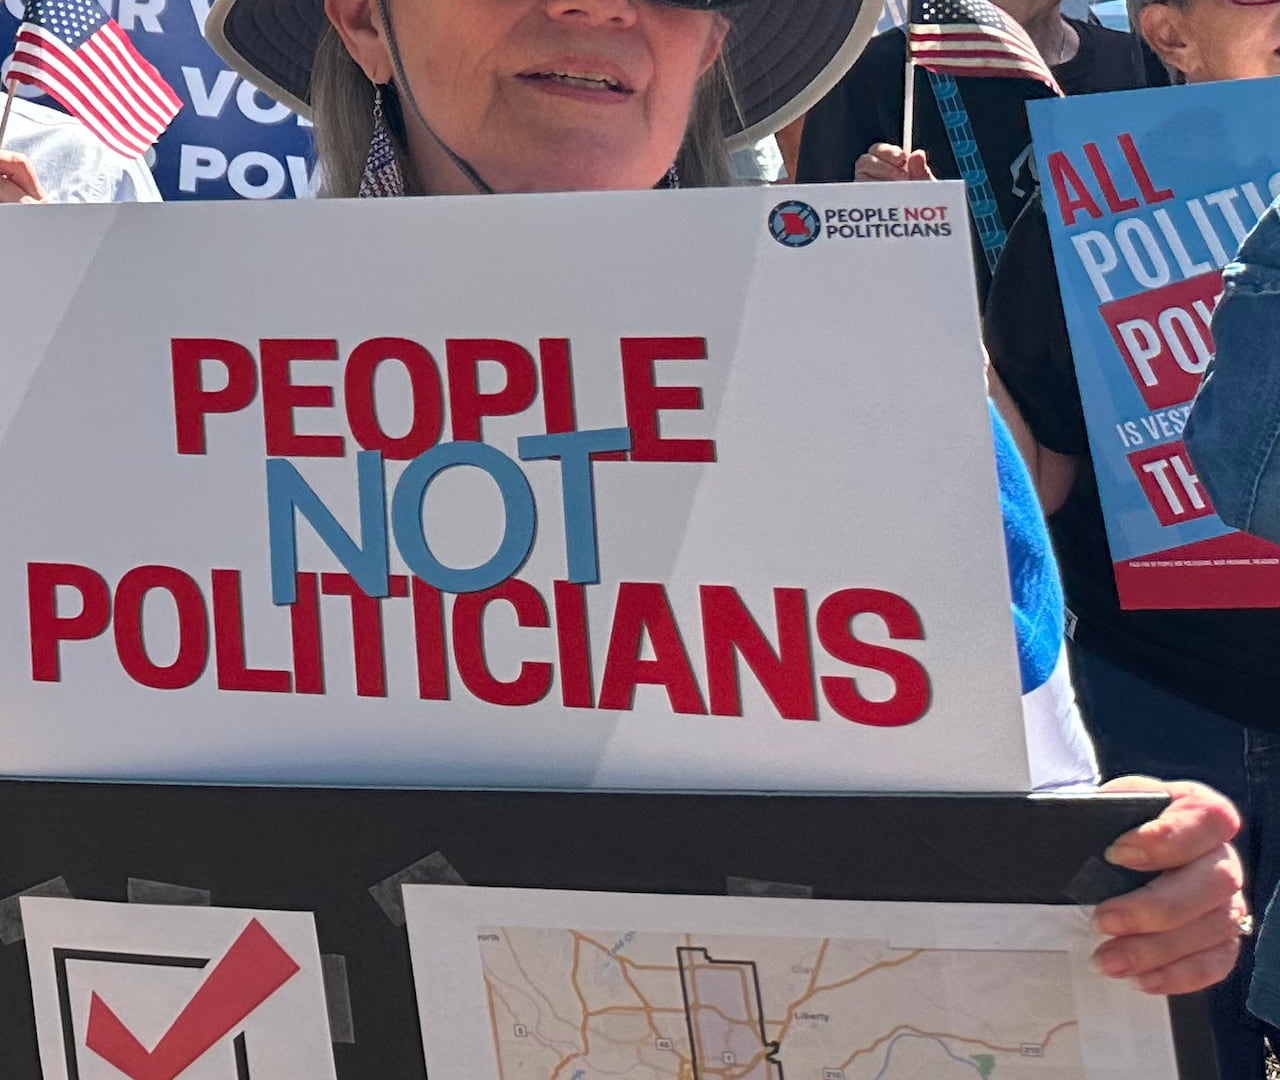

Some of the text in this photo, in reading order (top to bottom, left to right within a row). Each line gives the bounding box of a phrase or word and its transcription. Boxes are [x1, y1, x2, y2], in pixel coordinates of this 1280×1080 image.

[823, 206, 950, 225] PEOPLE NOT
[823, 221, 954, 242] POLITICIANS
[1047, 132, 1176, 226] ALL
[170, 335, 718, 466] PEOPLE
[264, 426, 633, 607] NOT
[27, 560, 934, 729] POLITICIANS
